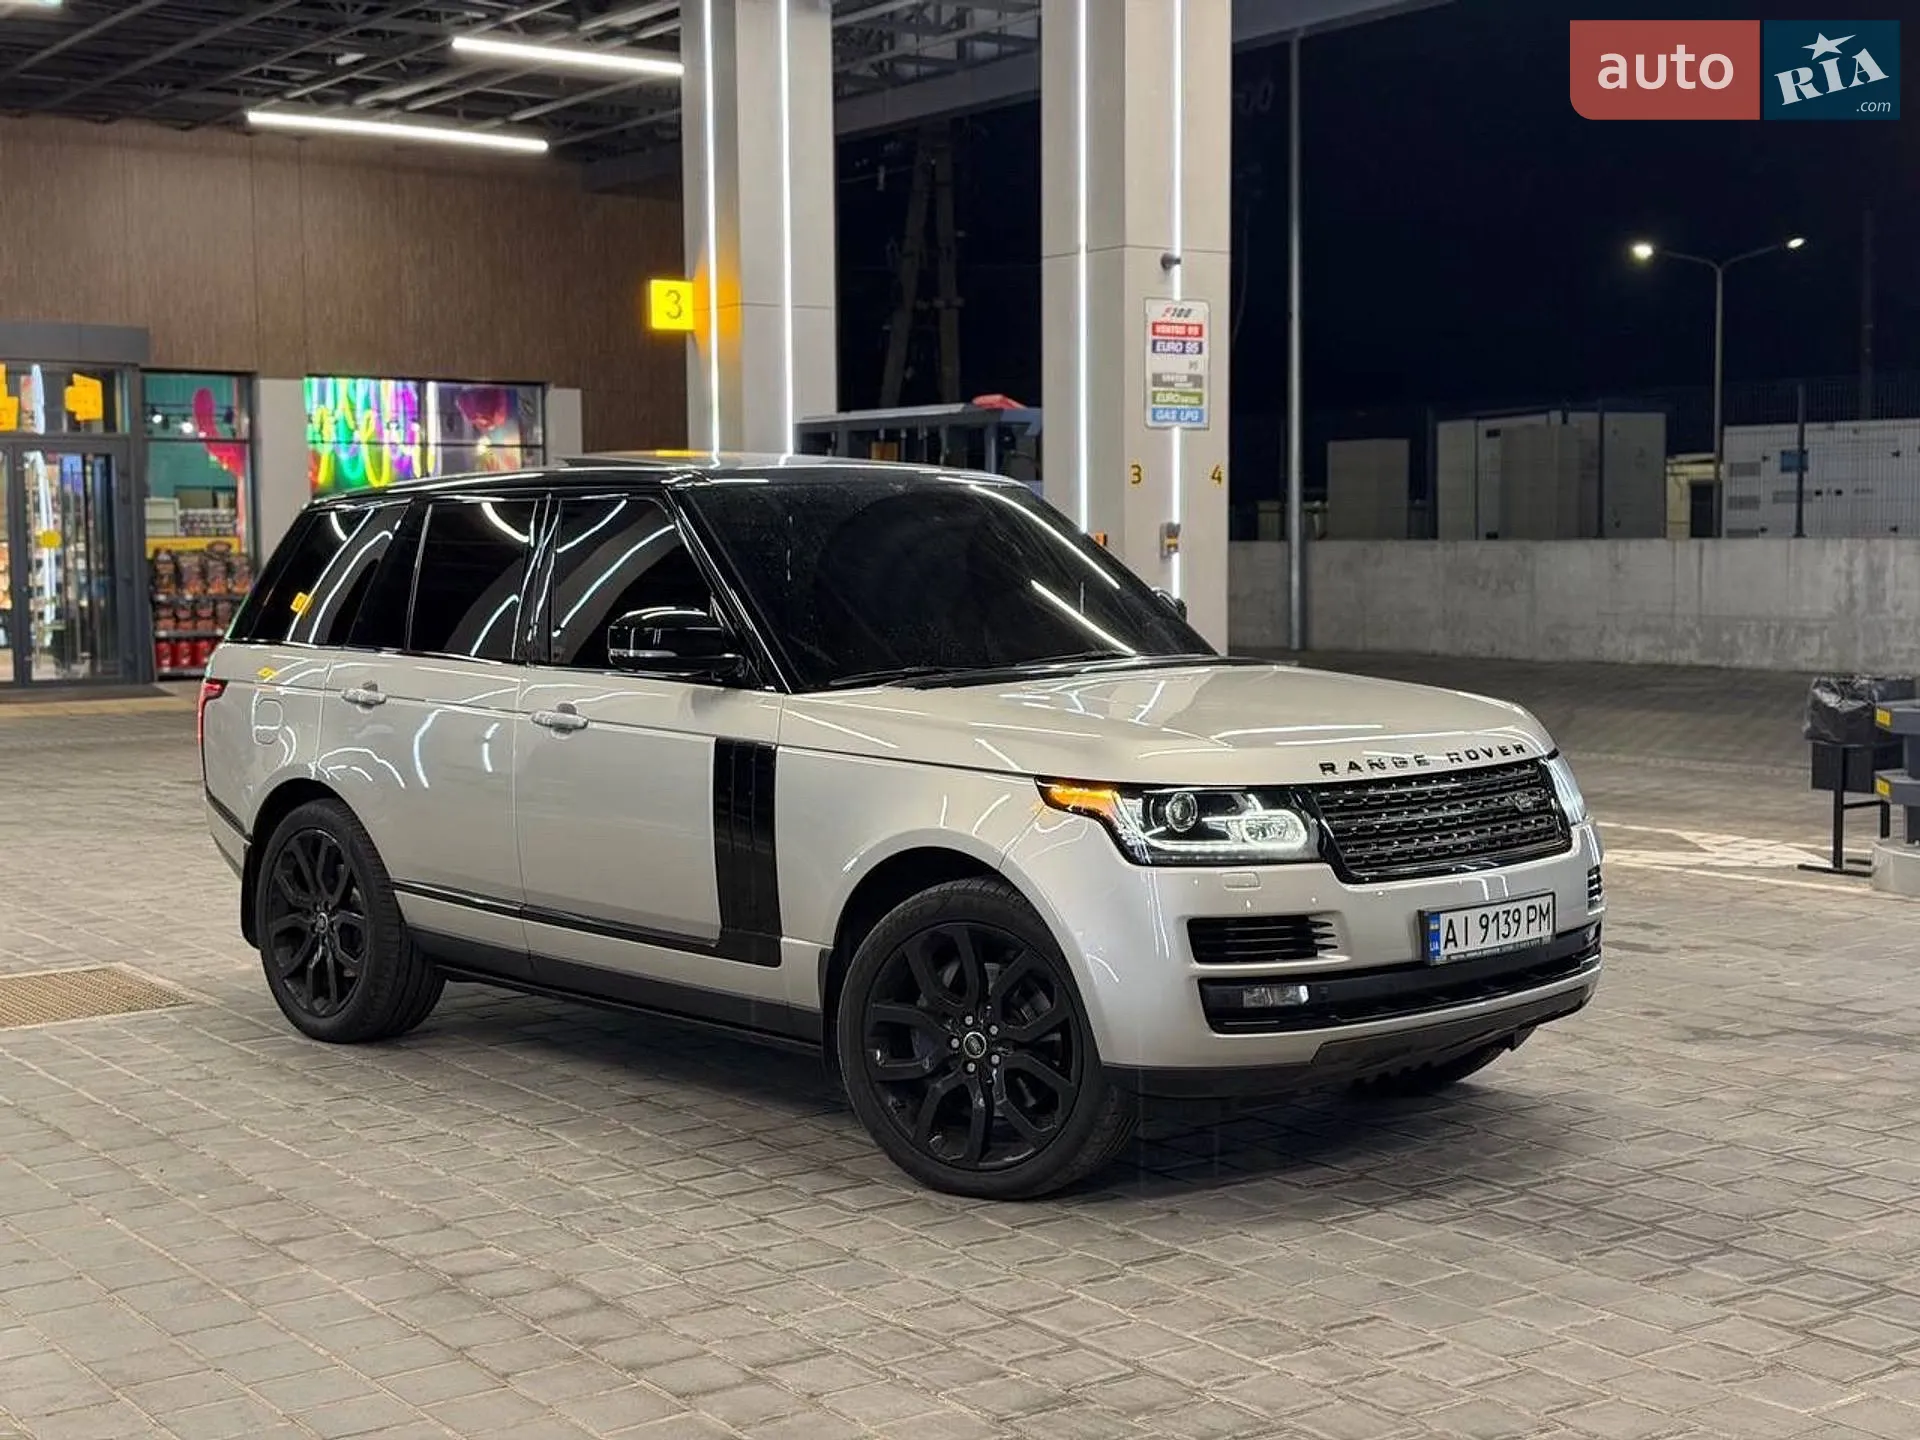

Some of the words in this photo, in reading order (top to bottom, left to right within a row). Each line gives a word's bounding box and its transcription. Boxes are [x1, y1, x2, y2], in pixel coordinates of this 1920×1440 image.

[664, 289, 683, 320] 3
[1156, 342, 1184, 353] EURO
[1156, 410, 1178, 421] GAS
[1179, 410, 1201, 422] LPG
[1130, 463, 1142, 485] 3
[1211, 463, 1223, 485] 4
[1319, 754, 1431, 776] RANGE
[1446, 743, 1527, 765] ROVER
[1443, 915, 1468, 950] AI
[1479, 907, 1521, 944] 9139
[1526, 901, 1551, 935] PM
